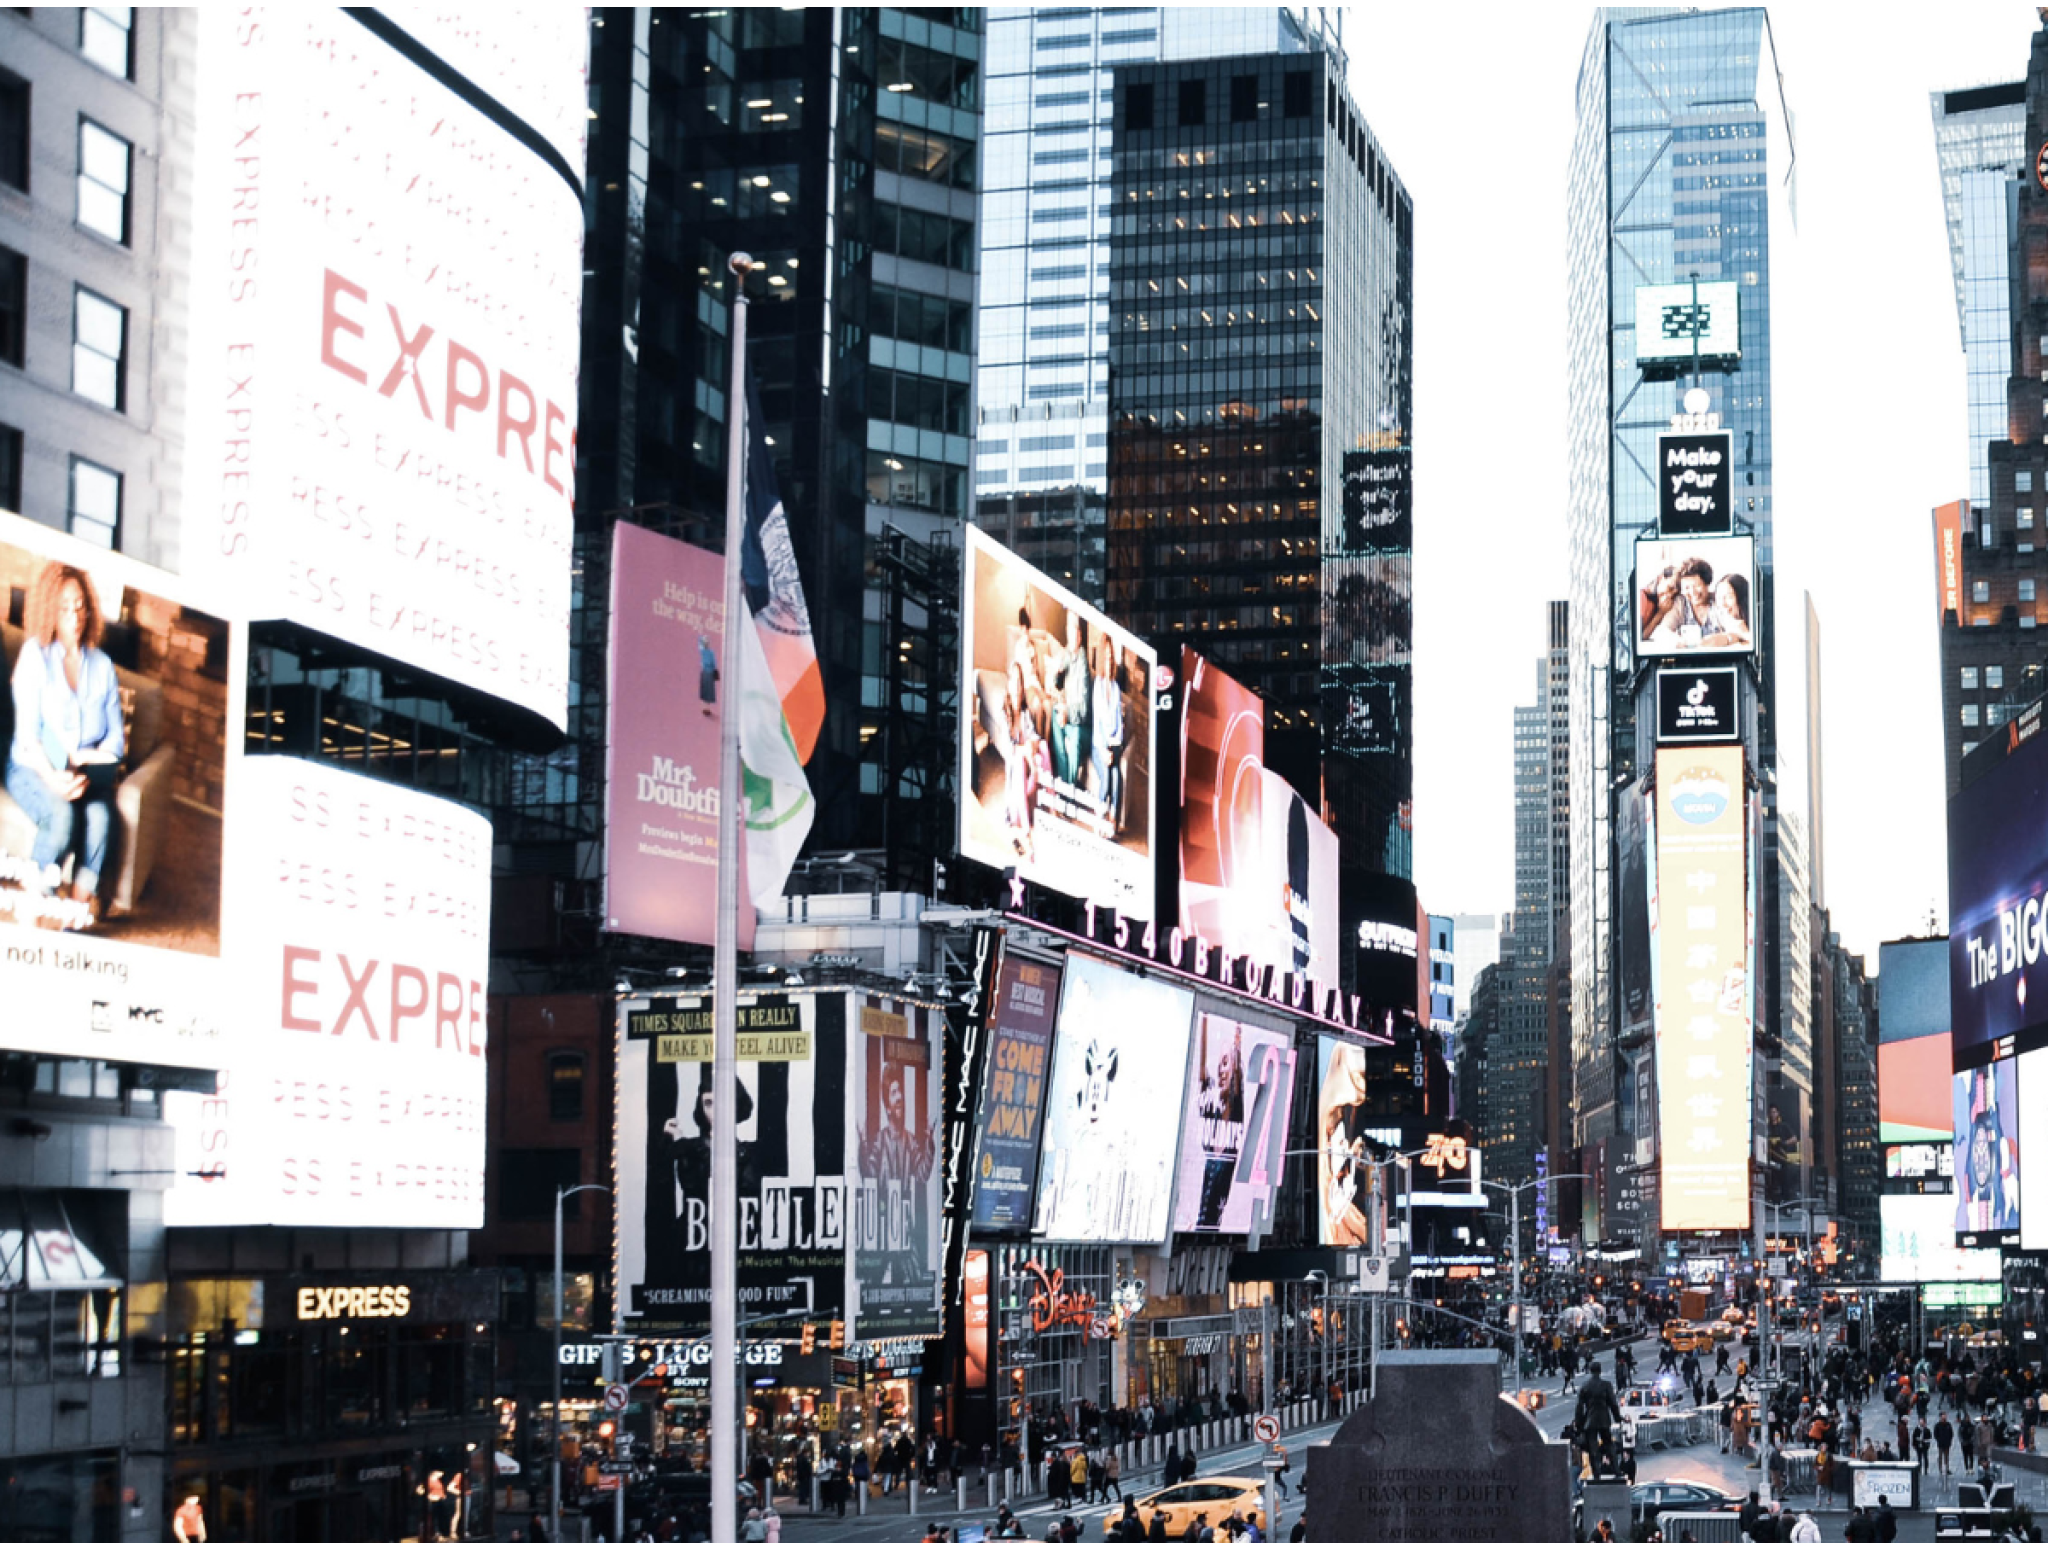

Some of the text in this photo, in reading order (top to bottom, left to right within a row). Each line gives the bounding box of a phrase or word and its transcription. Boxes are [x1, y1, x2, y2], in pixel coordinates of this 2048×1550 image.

[321, 267, 577, 512] EXPRE
[1667, 447, 1722, 467] Make
[1671, 469, 1717, 494] your
[1674, 492, 1716, 515] day.
[664, 580, 696, 610] Help
[652, 756, 697, 787] Mrs.
[7, 945, 129, 984] not talking
[1966, 936, 1997, 989] The
[281, 944, 488, 1057] EXPRE
[632, 1013, 668, 1034] TIMES
[750, 1006, 798, 1027] REALLY
[662, 1039, 699, 1057] MAKE
[767, 1037, 806, 1055] ALIVE!
[996, 1038, 1046, 1076] COME
[986, 1103, 1038, 1140] AWAY
[297, 1284, 411, 1320] EXPRESS
[736, 1287, 762, 1302] OOD
[673, 1377, 708, 1387] SONY
[359, 1465, 401, 1482] EXPRESS
[1358, 1485, 1433, 1503] FRANCIS
[1455, 1484, 1520, 1503] DUFFY
[1867, 1480, 1910, 1494] FROZEN
[1379, 1527, 1497, 1541] CATHOLIC PRIEST
